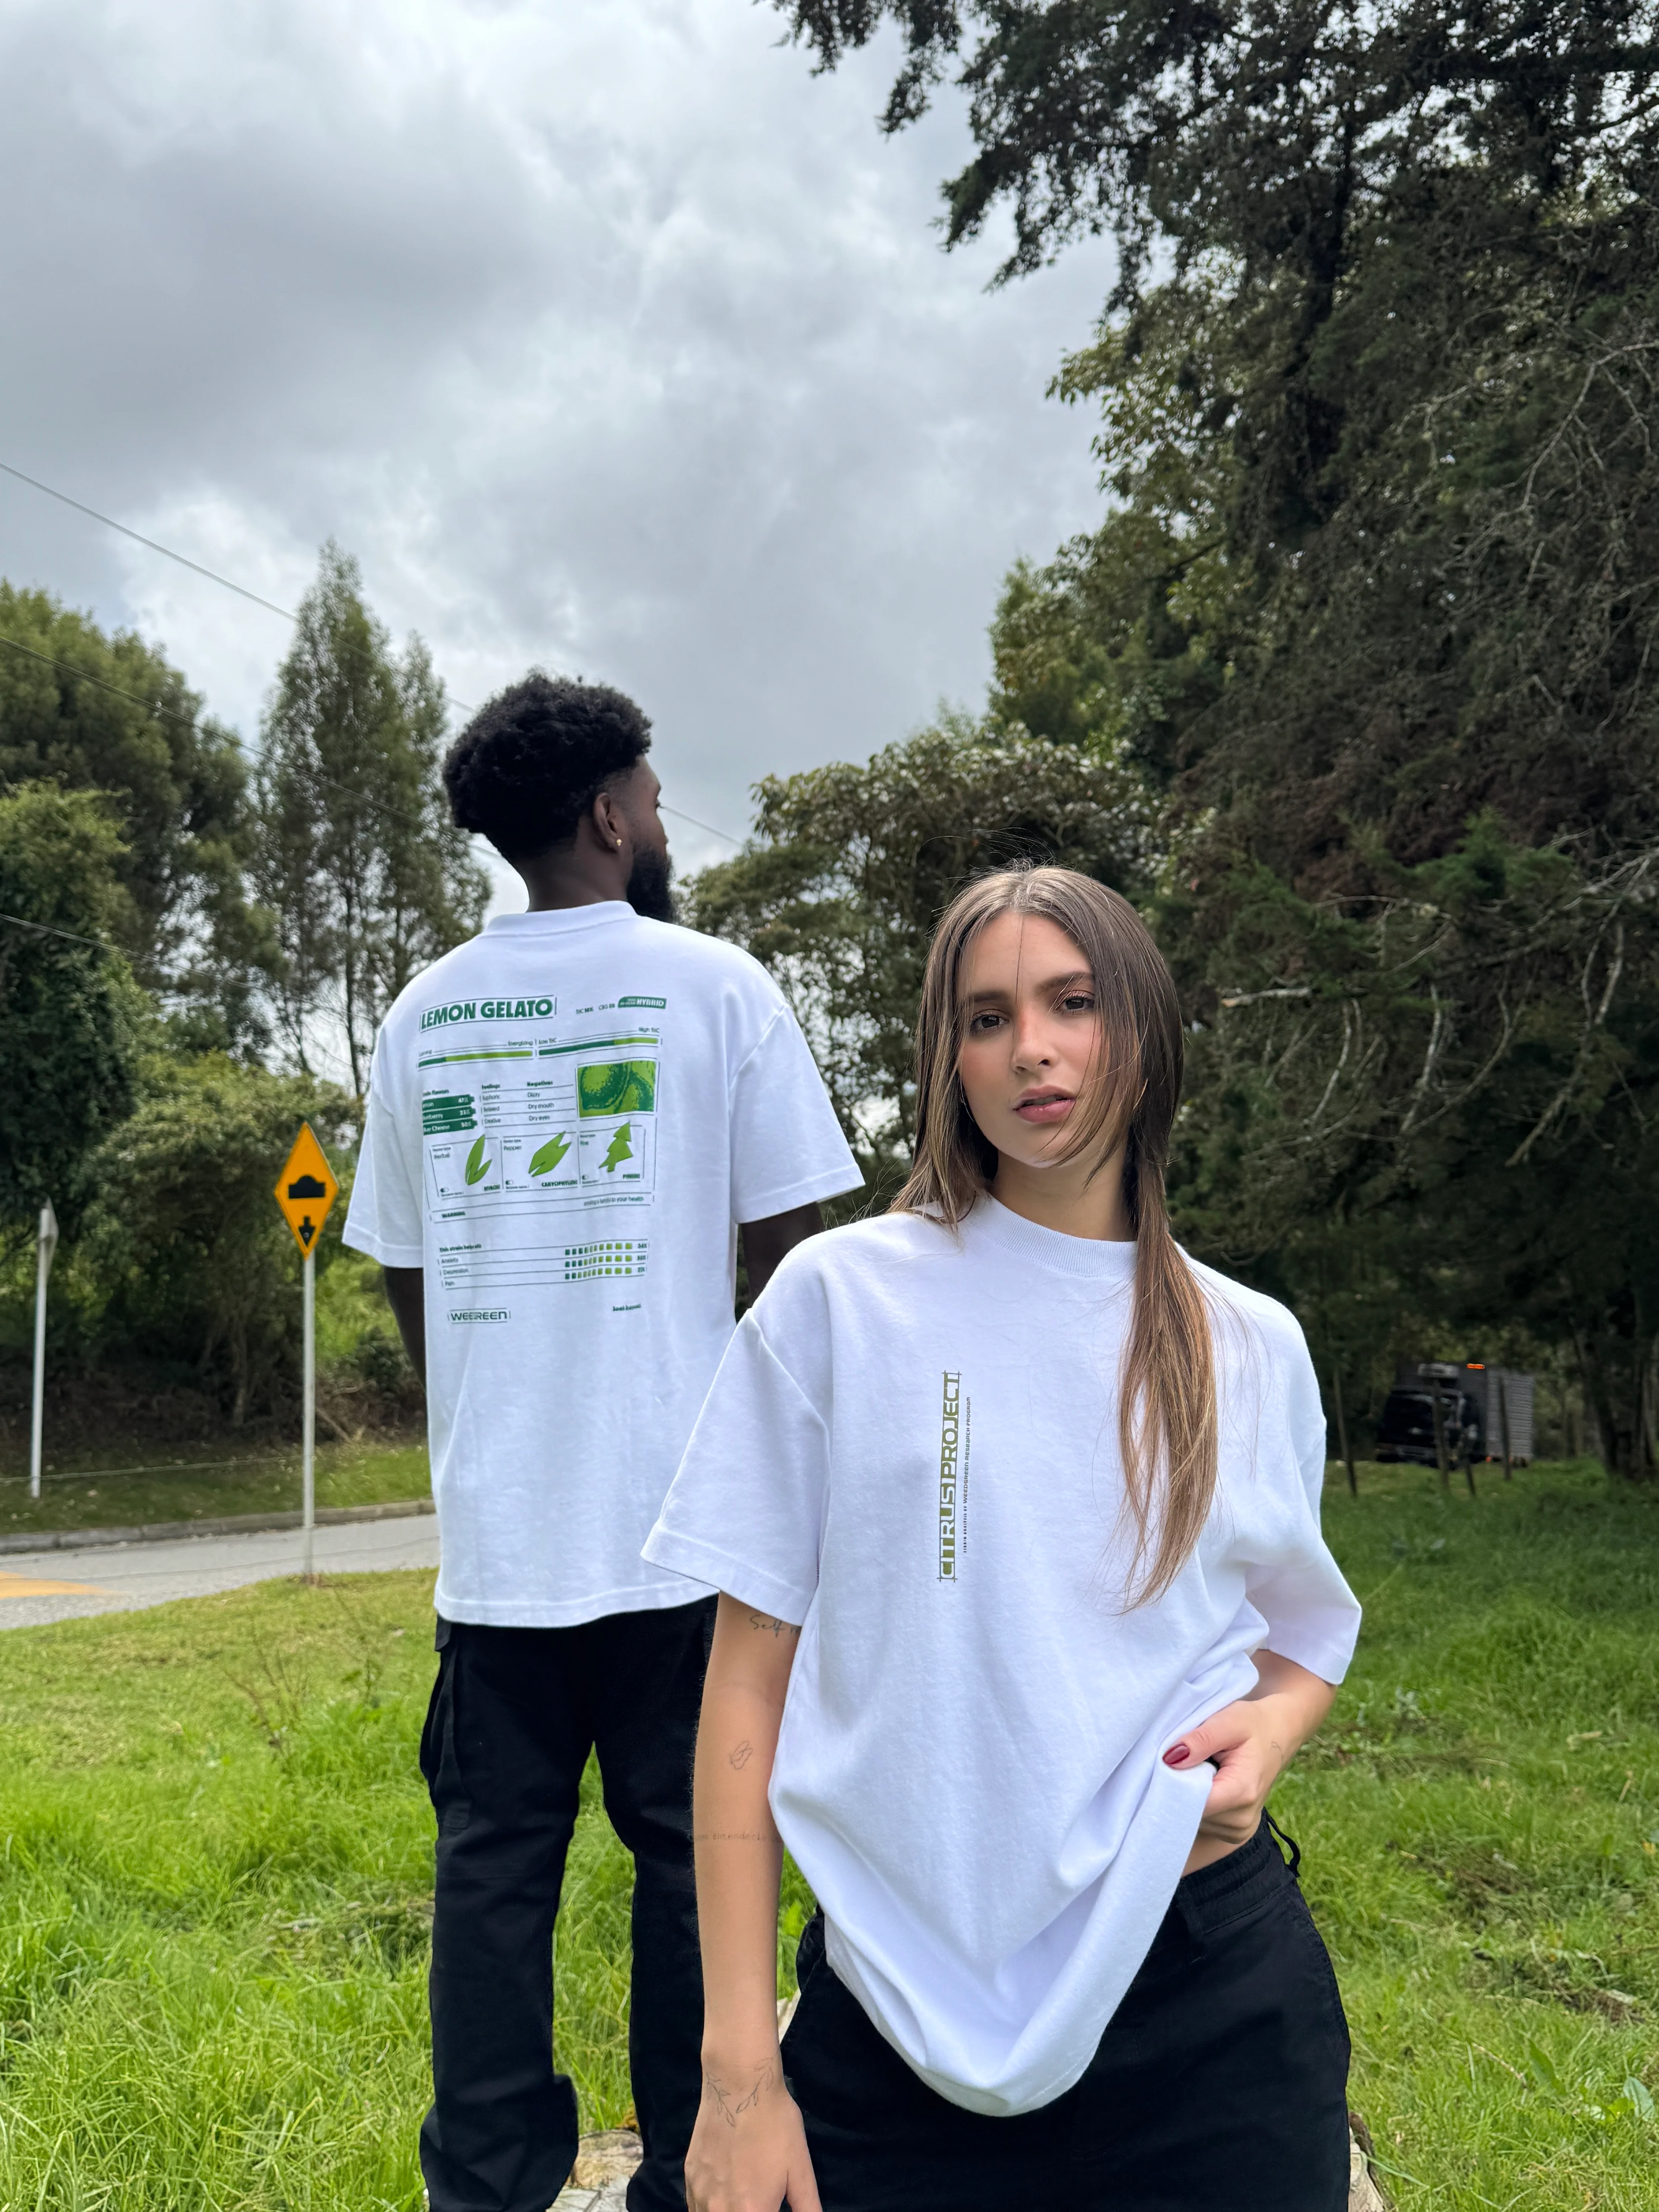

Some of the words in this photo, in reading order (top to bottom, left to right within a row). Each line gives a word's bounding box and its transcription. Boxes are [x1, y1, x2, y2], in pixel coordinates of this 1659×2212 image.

[636, 998, 665, 1007] HYBRID
[421, 1002, 477, 1030] LEMON
[481, 999, 553, 1018] GELATO
